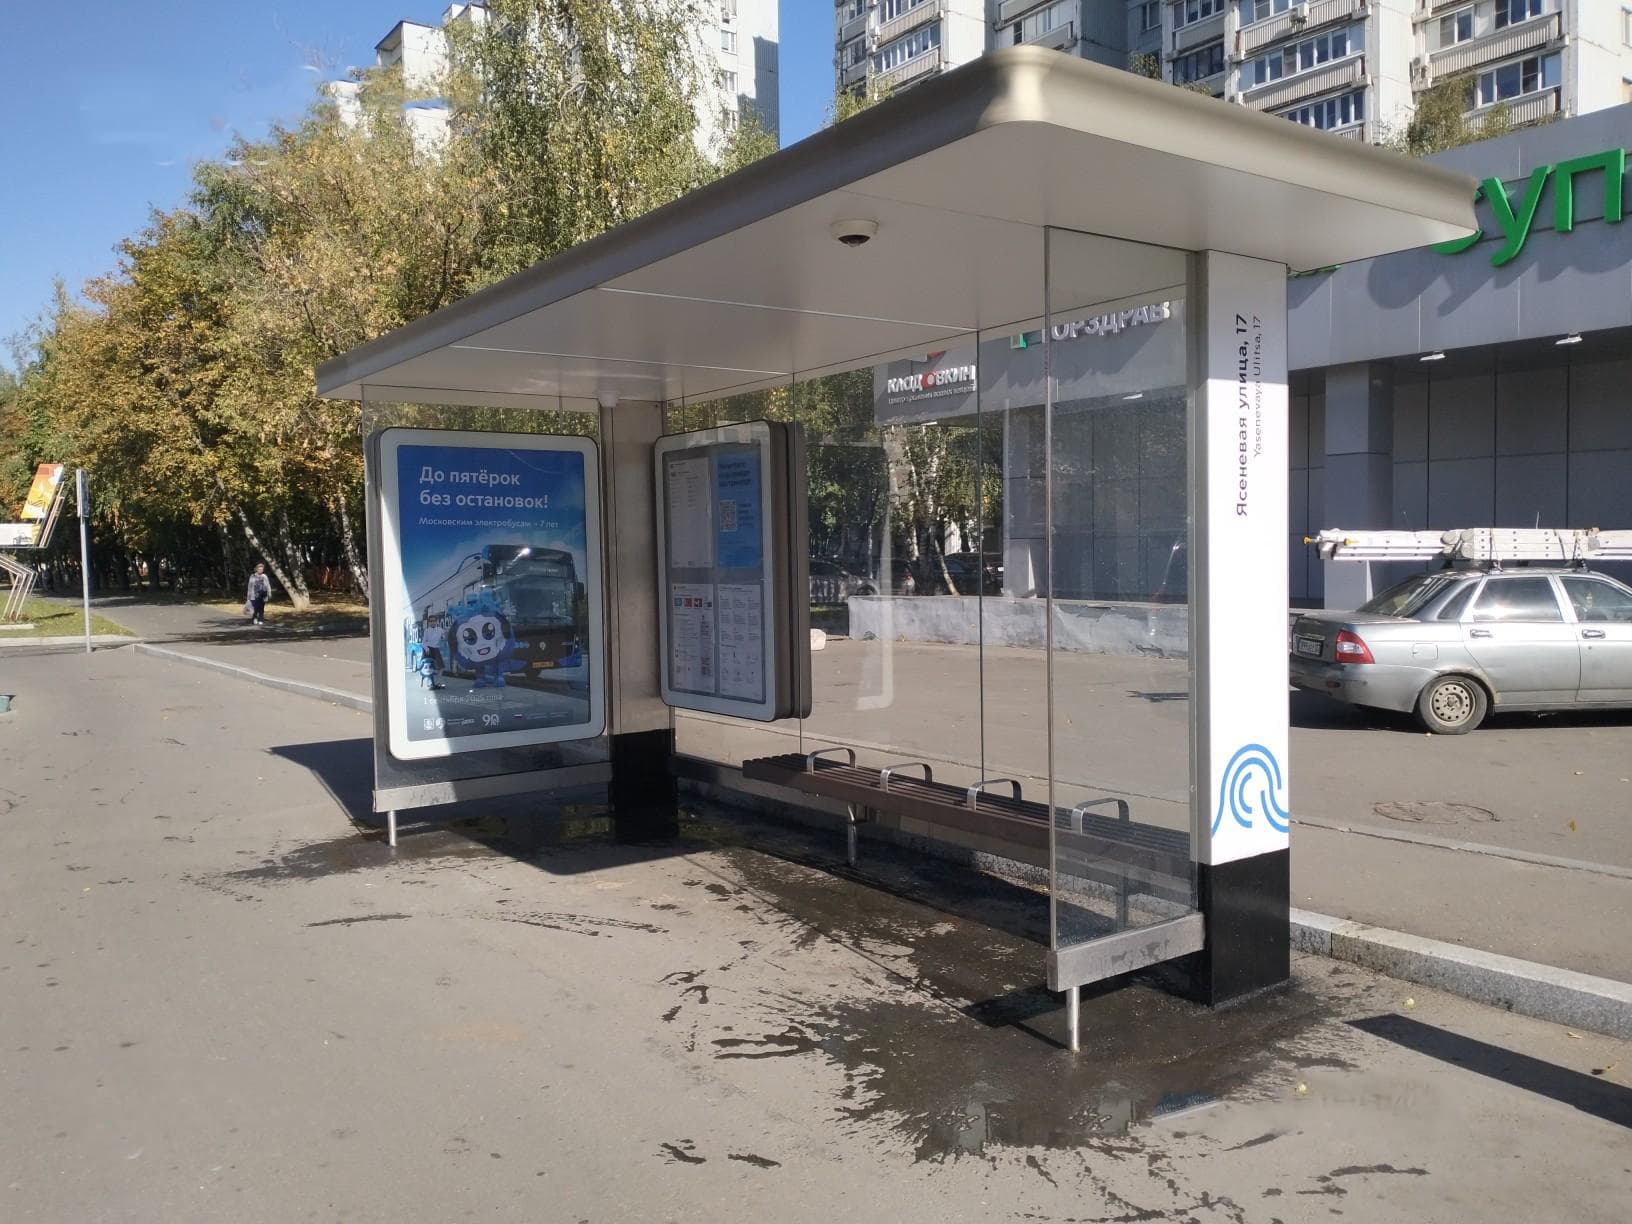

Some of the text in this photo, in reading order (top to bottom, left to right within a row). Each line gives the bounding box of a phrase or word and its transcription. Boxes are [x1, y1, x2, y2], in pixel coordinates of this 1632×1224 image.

[1042, 301, 1170, 344] ОРЗДРАВ
[1253, 315, 1263, 458] Yasenevaya Ulitsa, 17
[1236, 313, 1250, 517] Ясеневая улица, 17
[419, 466, 521, 487] До пятёрок
[420, 489, 548, 509] без остановок!
[418, 517, 473, 526] Московским
[475, 519, 530, 528] электробусам
